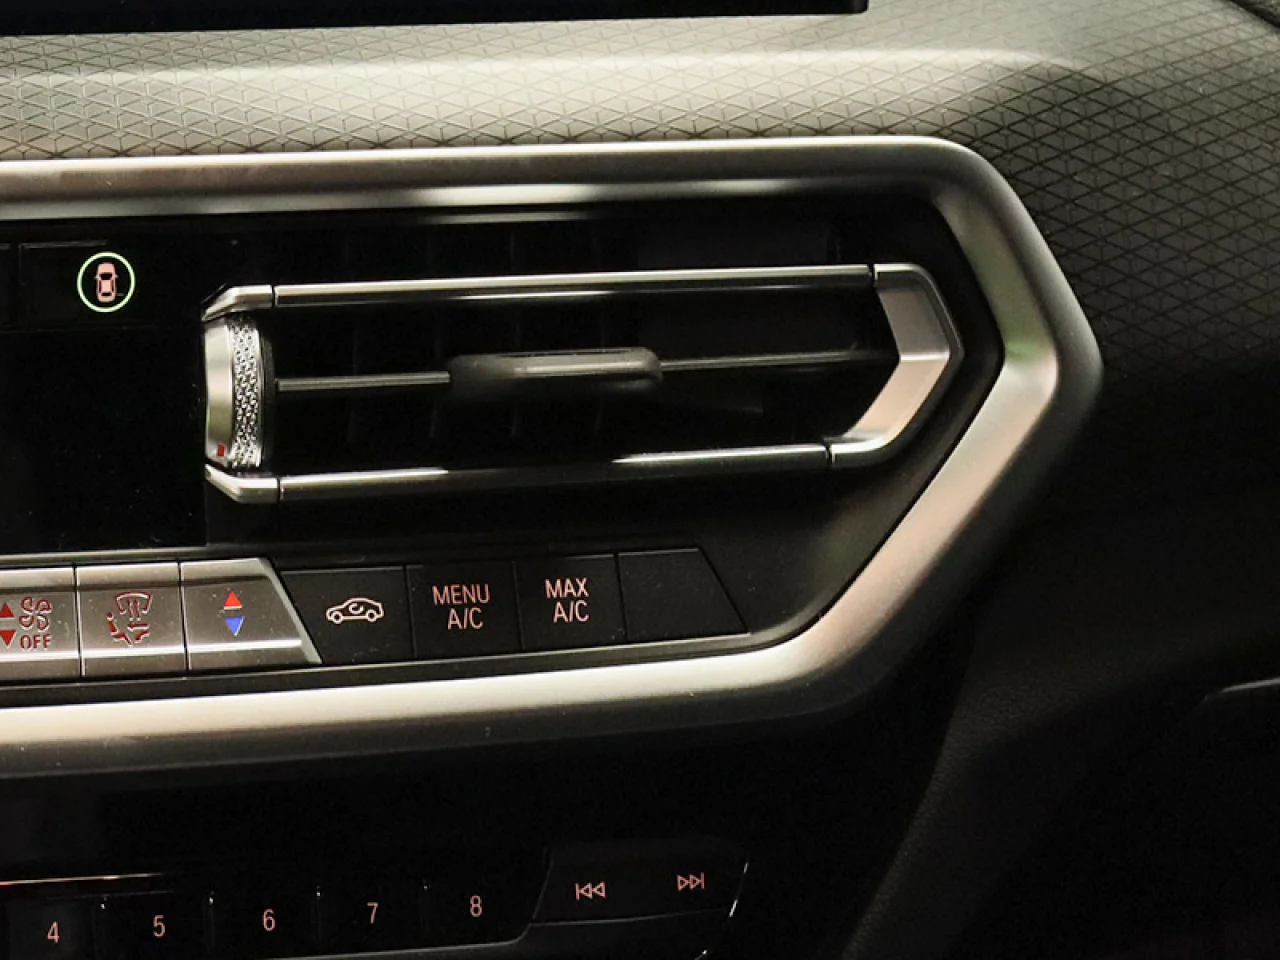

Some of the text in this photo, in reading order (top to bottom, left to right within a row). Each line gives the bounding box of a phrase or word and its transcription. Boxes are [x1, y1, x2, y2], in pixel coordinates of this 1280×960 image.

[432, 583, 490, 605] MENU
[545, 577, 589, 598] MAX
[447, 607, 483, 630] A/C
[553, 599, 590, 623] A/C
[19, 634, 52, 651] OFF
[367, 902, 379, 924] 7
[470, 895, 483, 917] 8
[153, 914, 166, 937] 5
[263, 908, 276, 932] 6
[47, 921, 60, 943] 4
